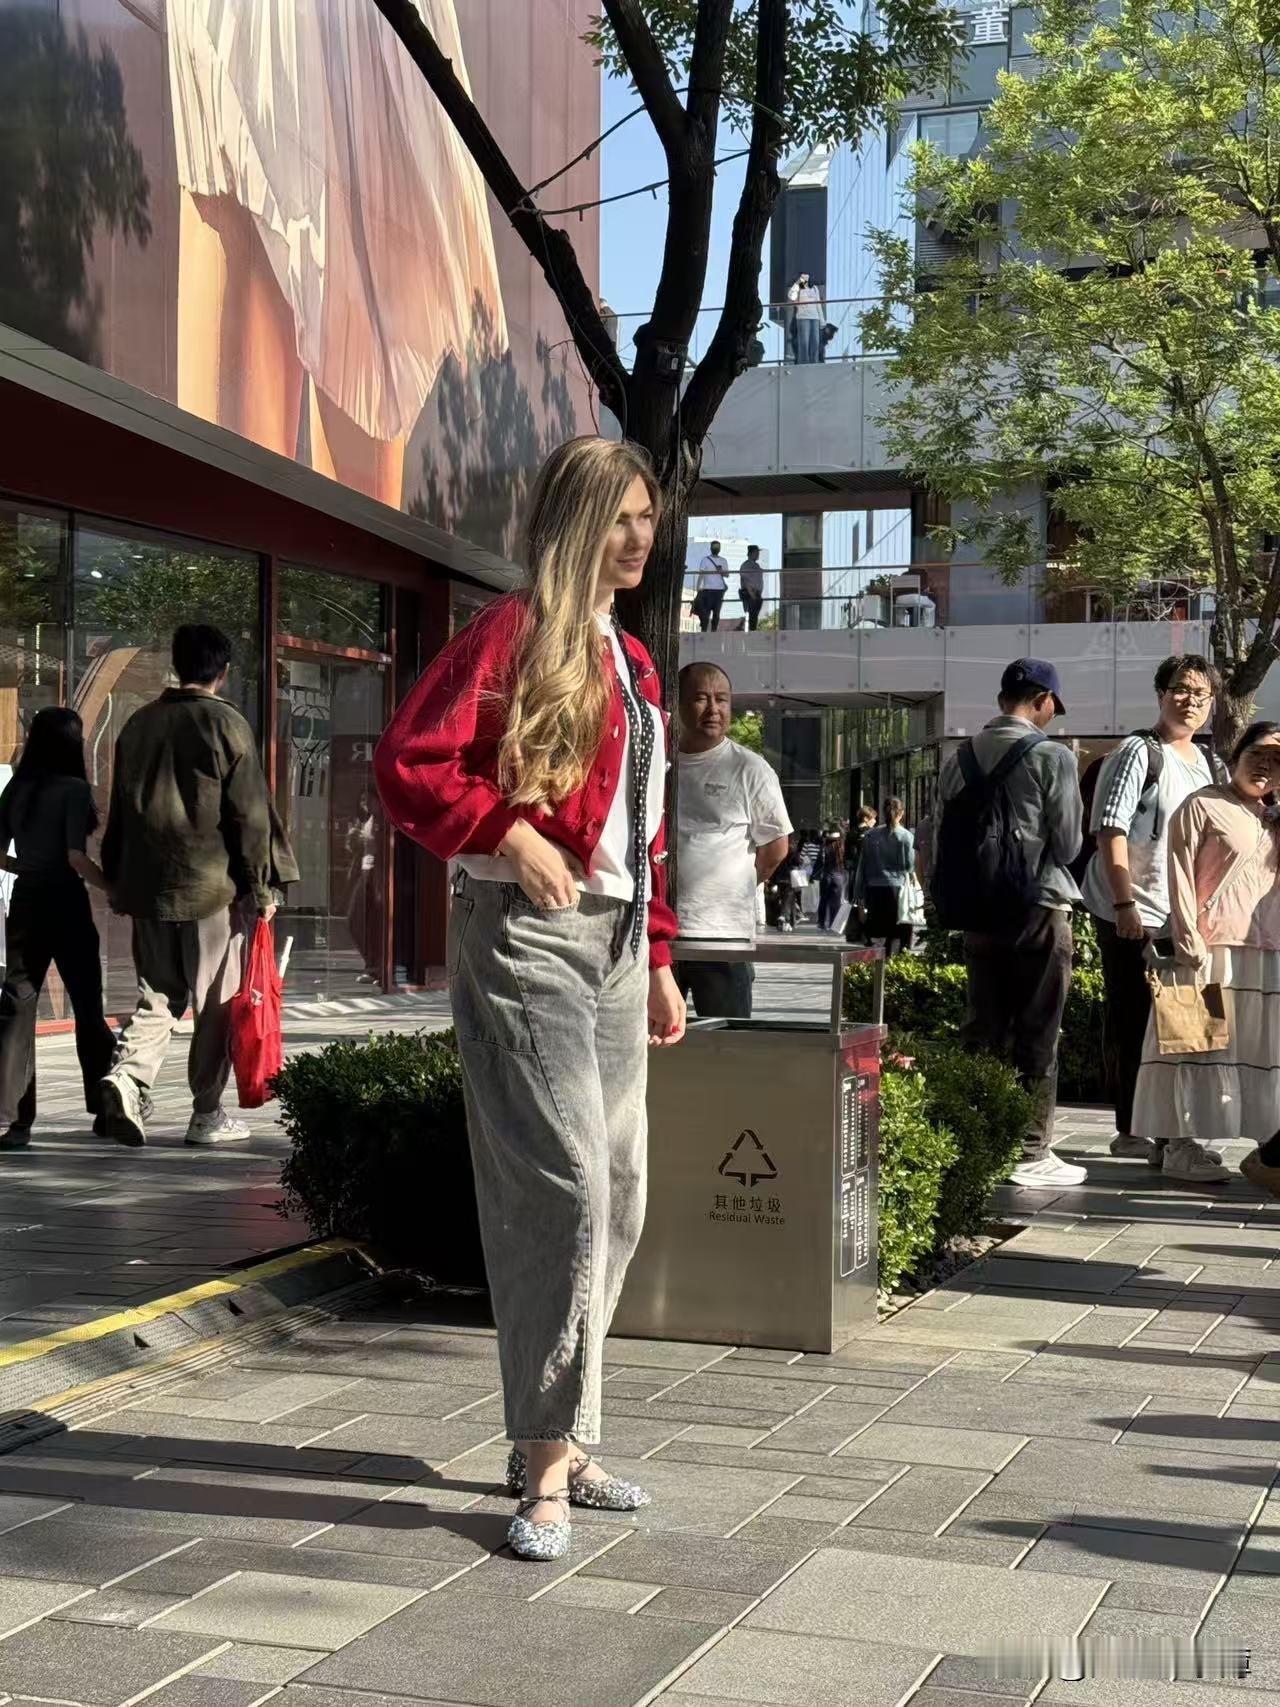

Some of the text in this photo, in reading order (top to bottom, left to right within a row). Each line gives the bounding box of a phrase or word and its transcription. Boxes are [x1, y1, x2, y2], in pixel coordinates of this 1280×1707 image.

[714, 1194, 781, 1213] 其他垃圾
[709, 1211, 785, 1225] Residual Waste
